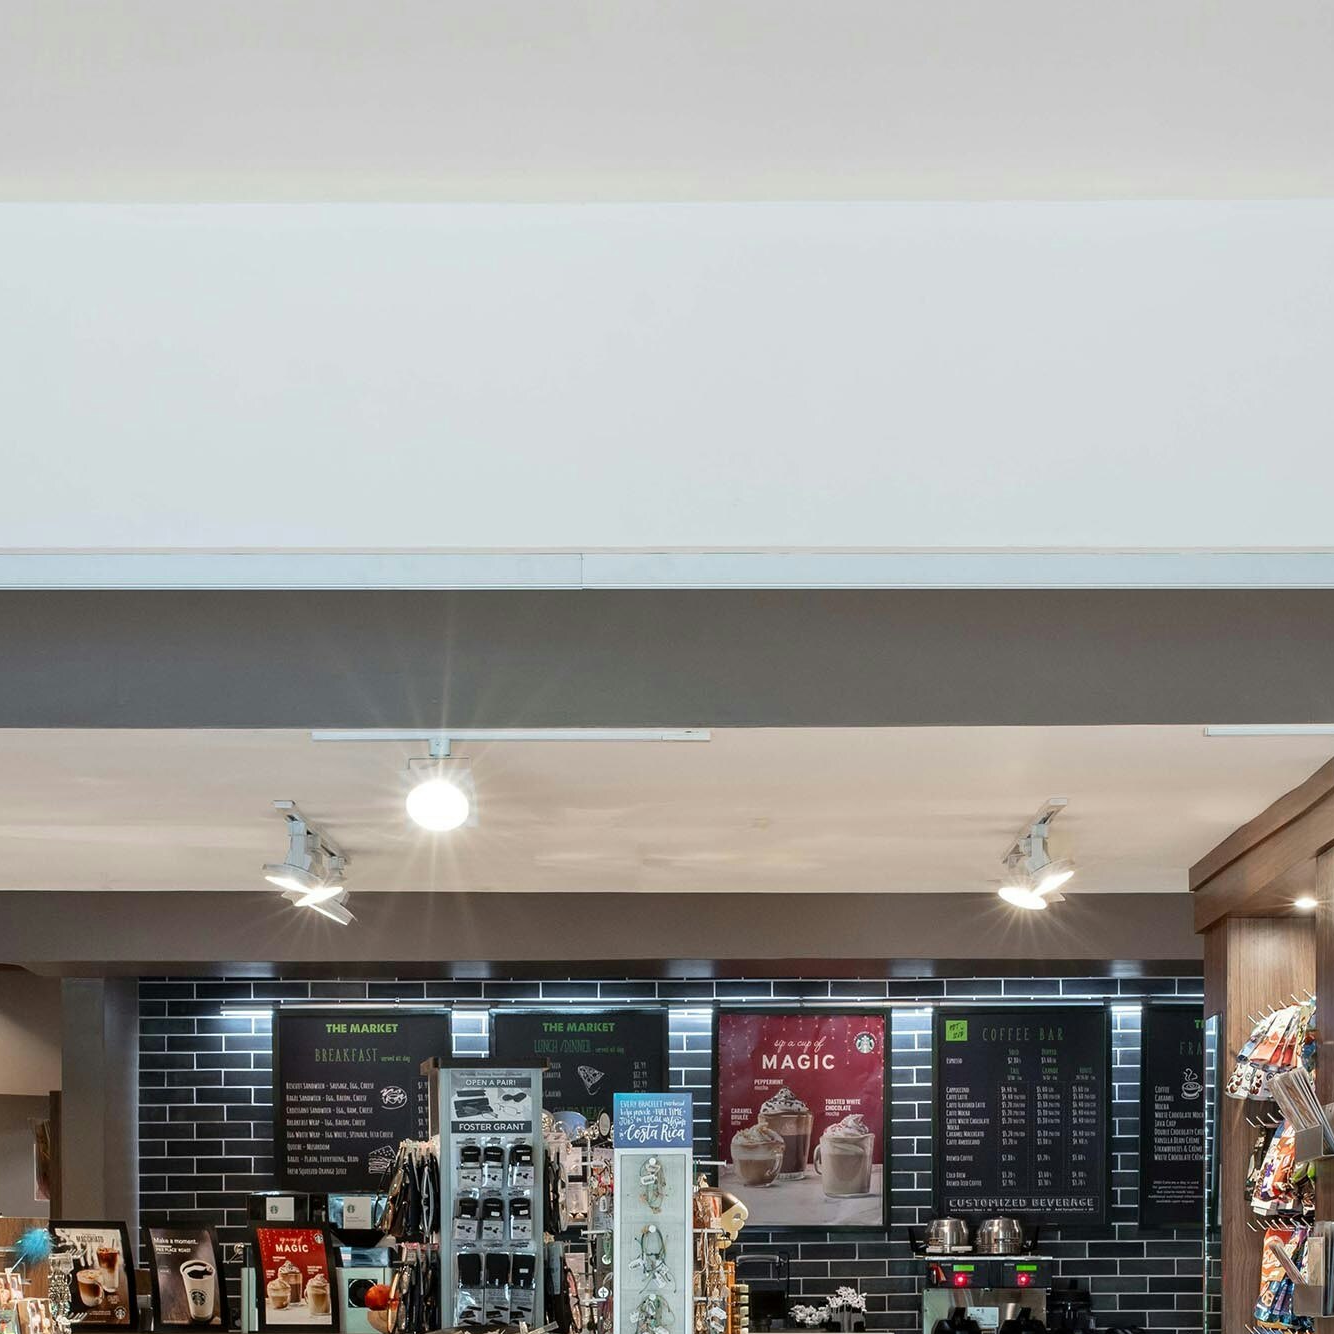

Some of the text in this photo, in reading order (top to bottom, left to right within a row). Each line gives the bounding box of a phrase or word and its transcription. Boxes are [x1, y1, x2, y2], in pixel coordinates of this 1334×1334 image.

[326, 1024, 398, 1033] THE MARKET
[543, 1023, 615, 1032] THE MARKET
[983, 1028, 1064, 1040] COFFEE BAR
[774, 1039, 786, 1053] sip
[797, 1040, 812, 1054] cup
[813, 1036, 827, 1053] of
[315, 1048, 378, 1062] BREAKFAST
[762, 1054, 835, 1070] MAGIC
[459, 1123, 525, 1131] FOSTER GRANT
[624, 1124, 685, 1143] Costa Rica
[949, 1198, 1094, 1208] CUSTOMIZED BEVERAGE
[275, 1244, 309, 1252] MAGIC
